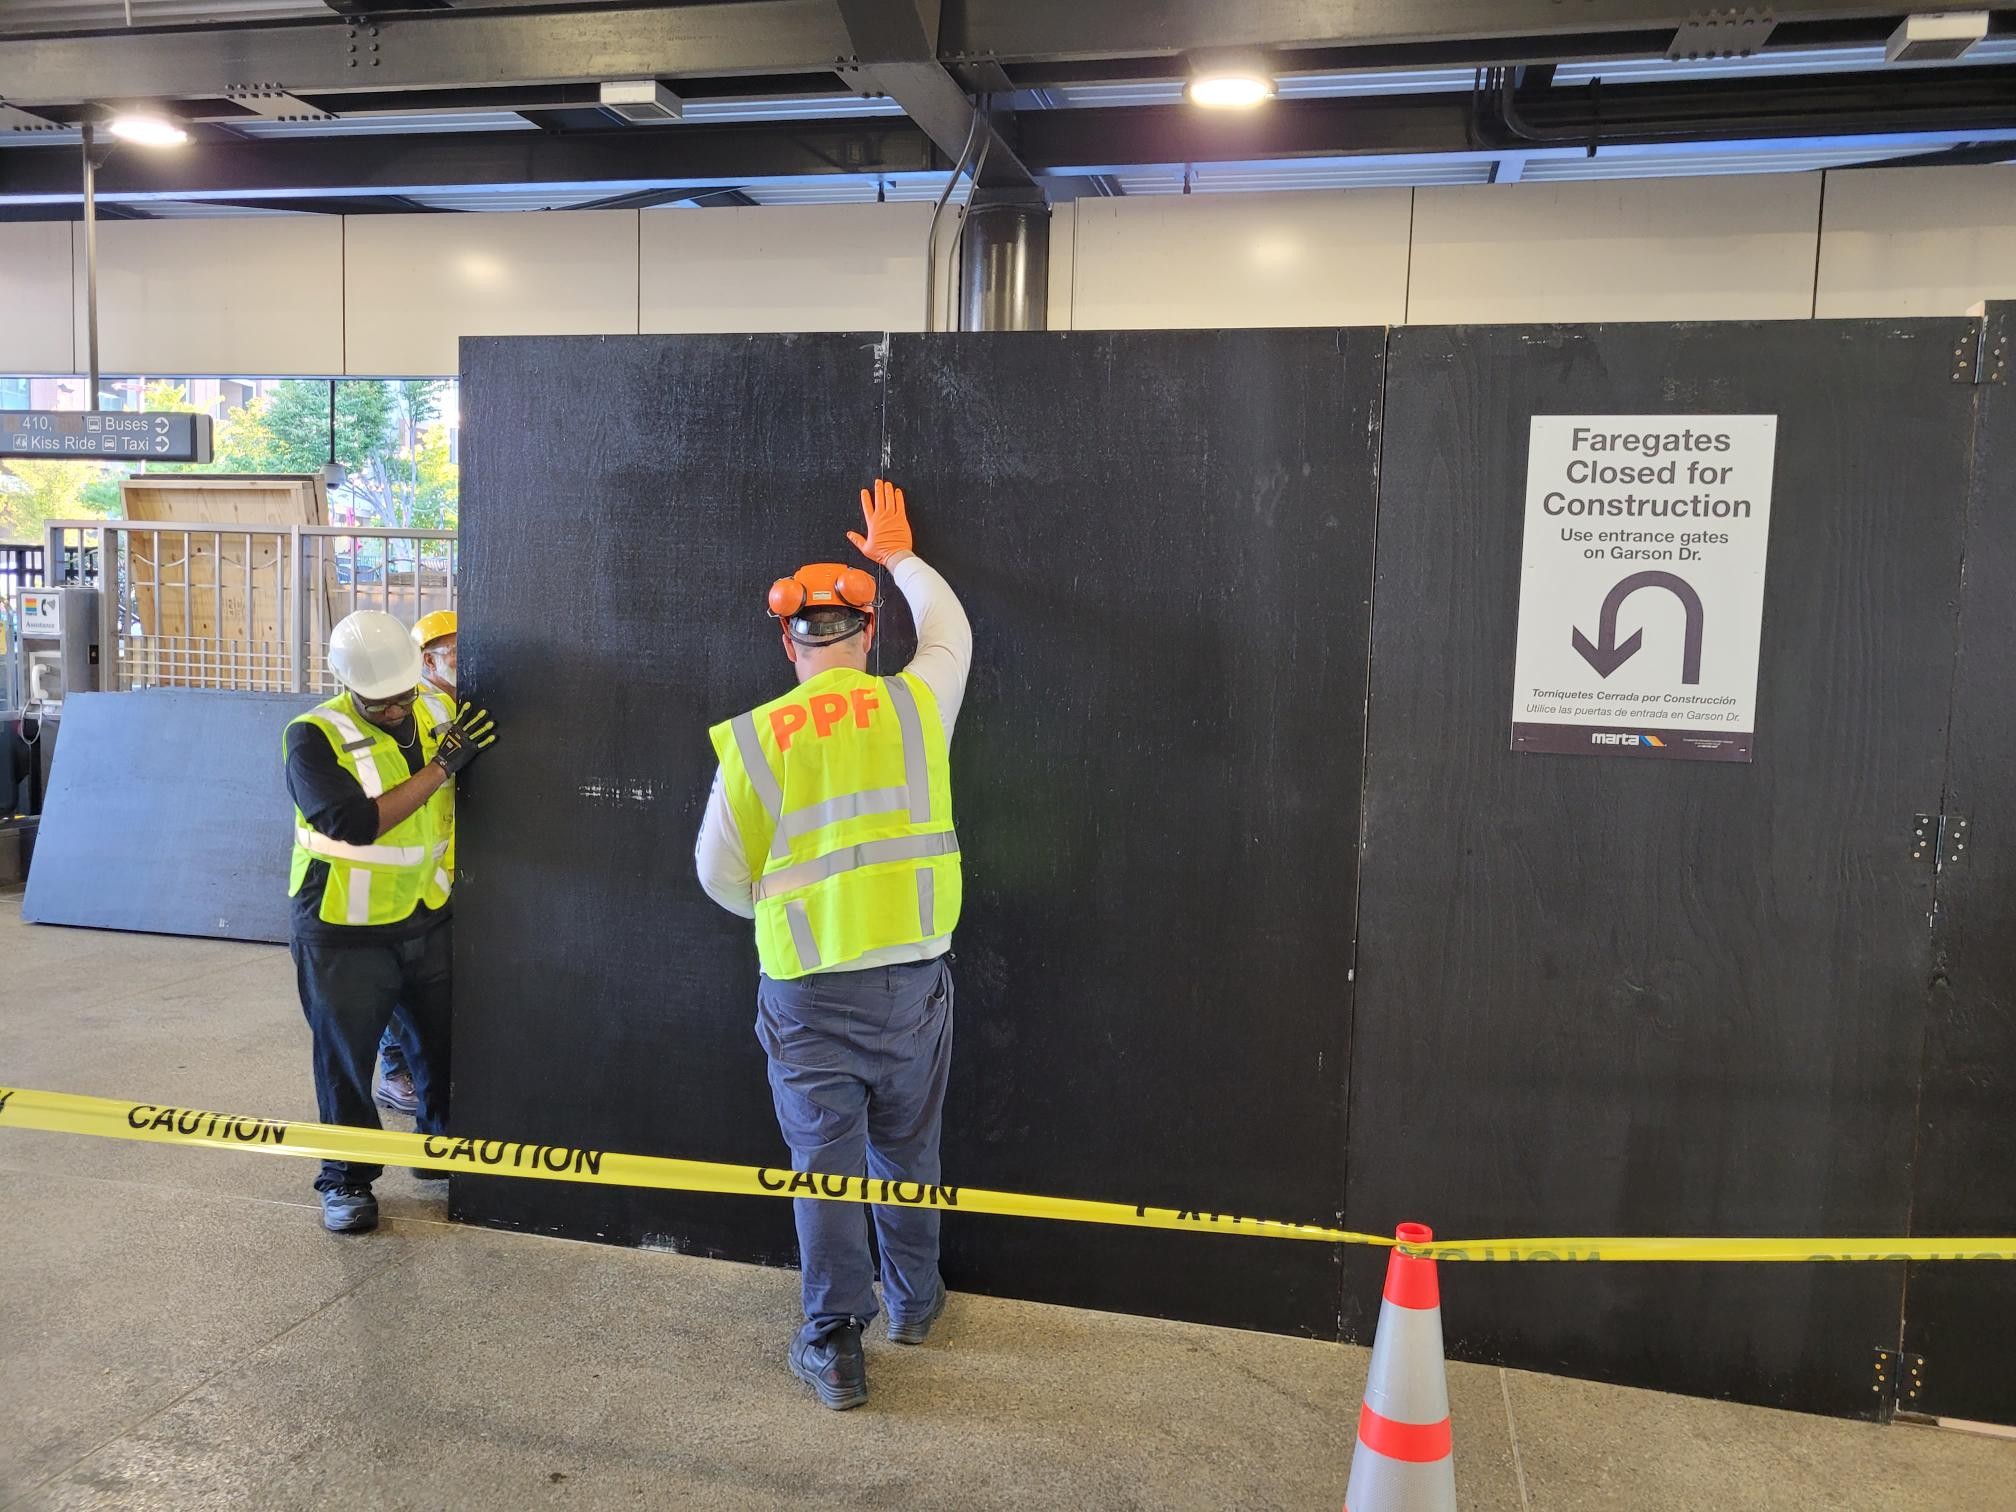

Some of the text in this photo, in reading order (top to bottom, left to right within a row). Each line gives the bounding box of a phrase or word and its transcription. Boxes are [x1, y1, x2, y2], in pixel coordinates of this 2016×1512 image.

[22, 416, 149, 432] 410, Buses
[31, 435, 149, 451] Kiss Ride Taxi
[1571, 427, 1732, 458] Faregates
[1566, 459, 1734, 485] Closed for
[1543, 491, 1752, 518] Construction
[1560, 527, 1729, 547] Use entrance gates
[1583, 546, 1702, 562] on Garson Dr.
[1532, 688, 1737, 706] Torniquetes Cerrada por Construcción
[769, 687, 881, 753] PPF
[1526, 703, 1741, 722] Utilice las puertas de entrada en Garson Dr.
[1591, 732, 1640, 746] marta
[127, 1104, 289, 1145] CAUTION
[423, 1134, 604, 1176] CAUTION
[757, 1167, 959, 1206] CAUTION
